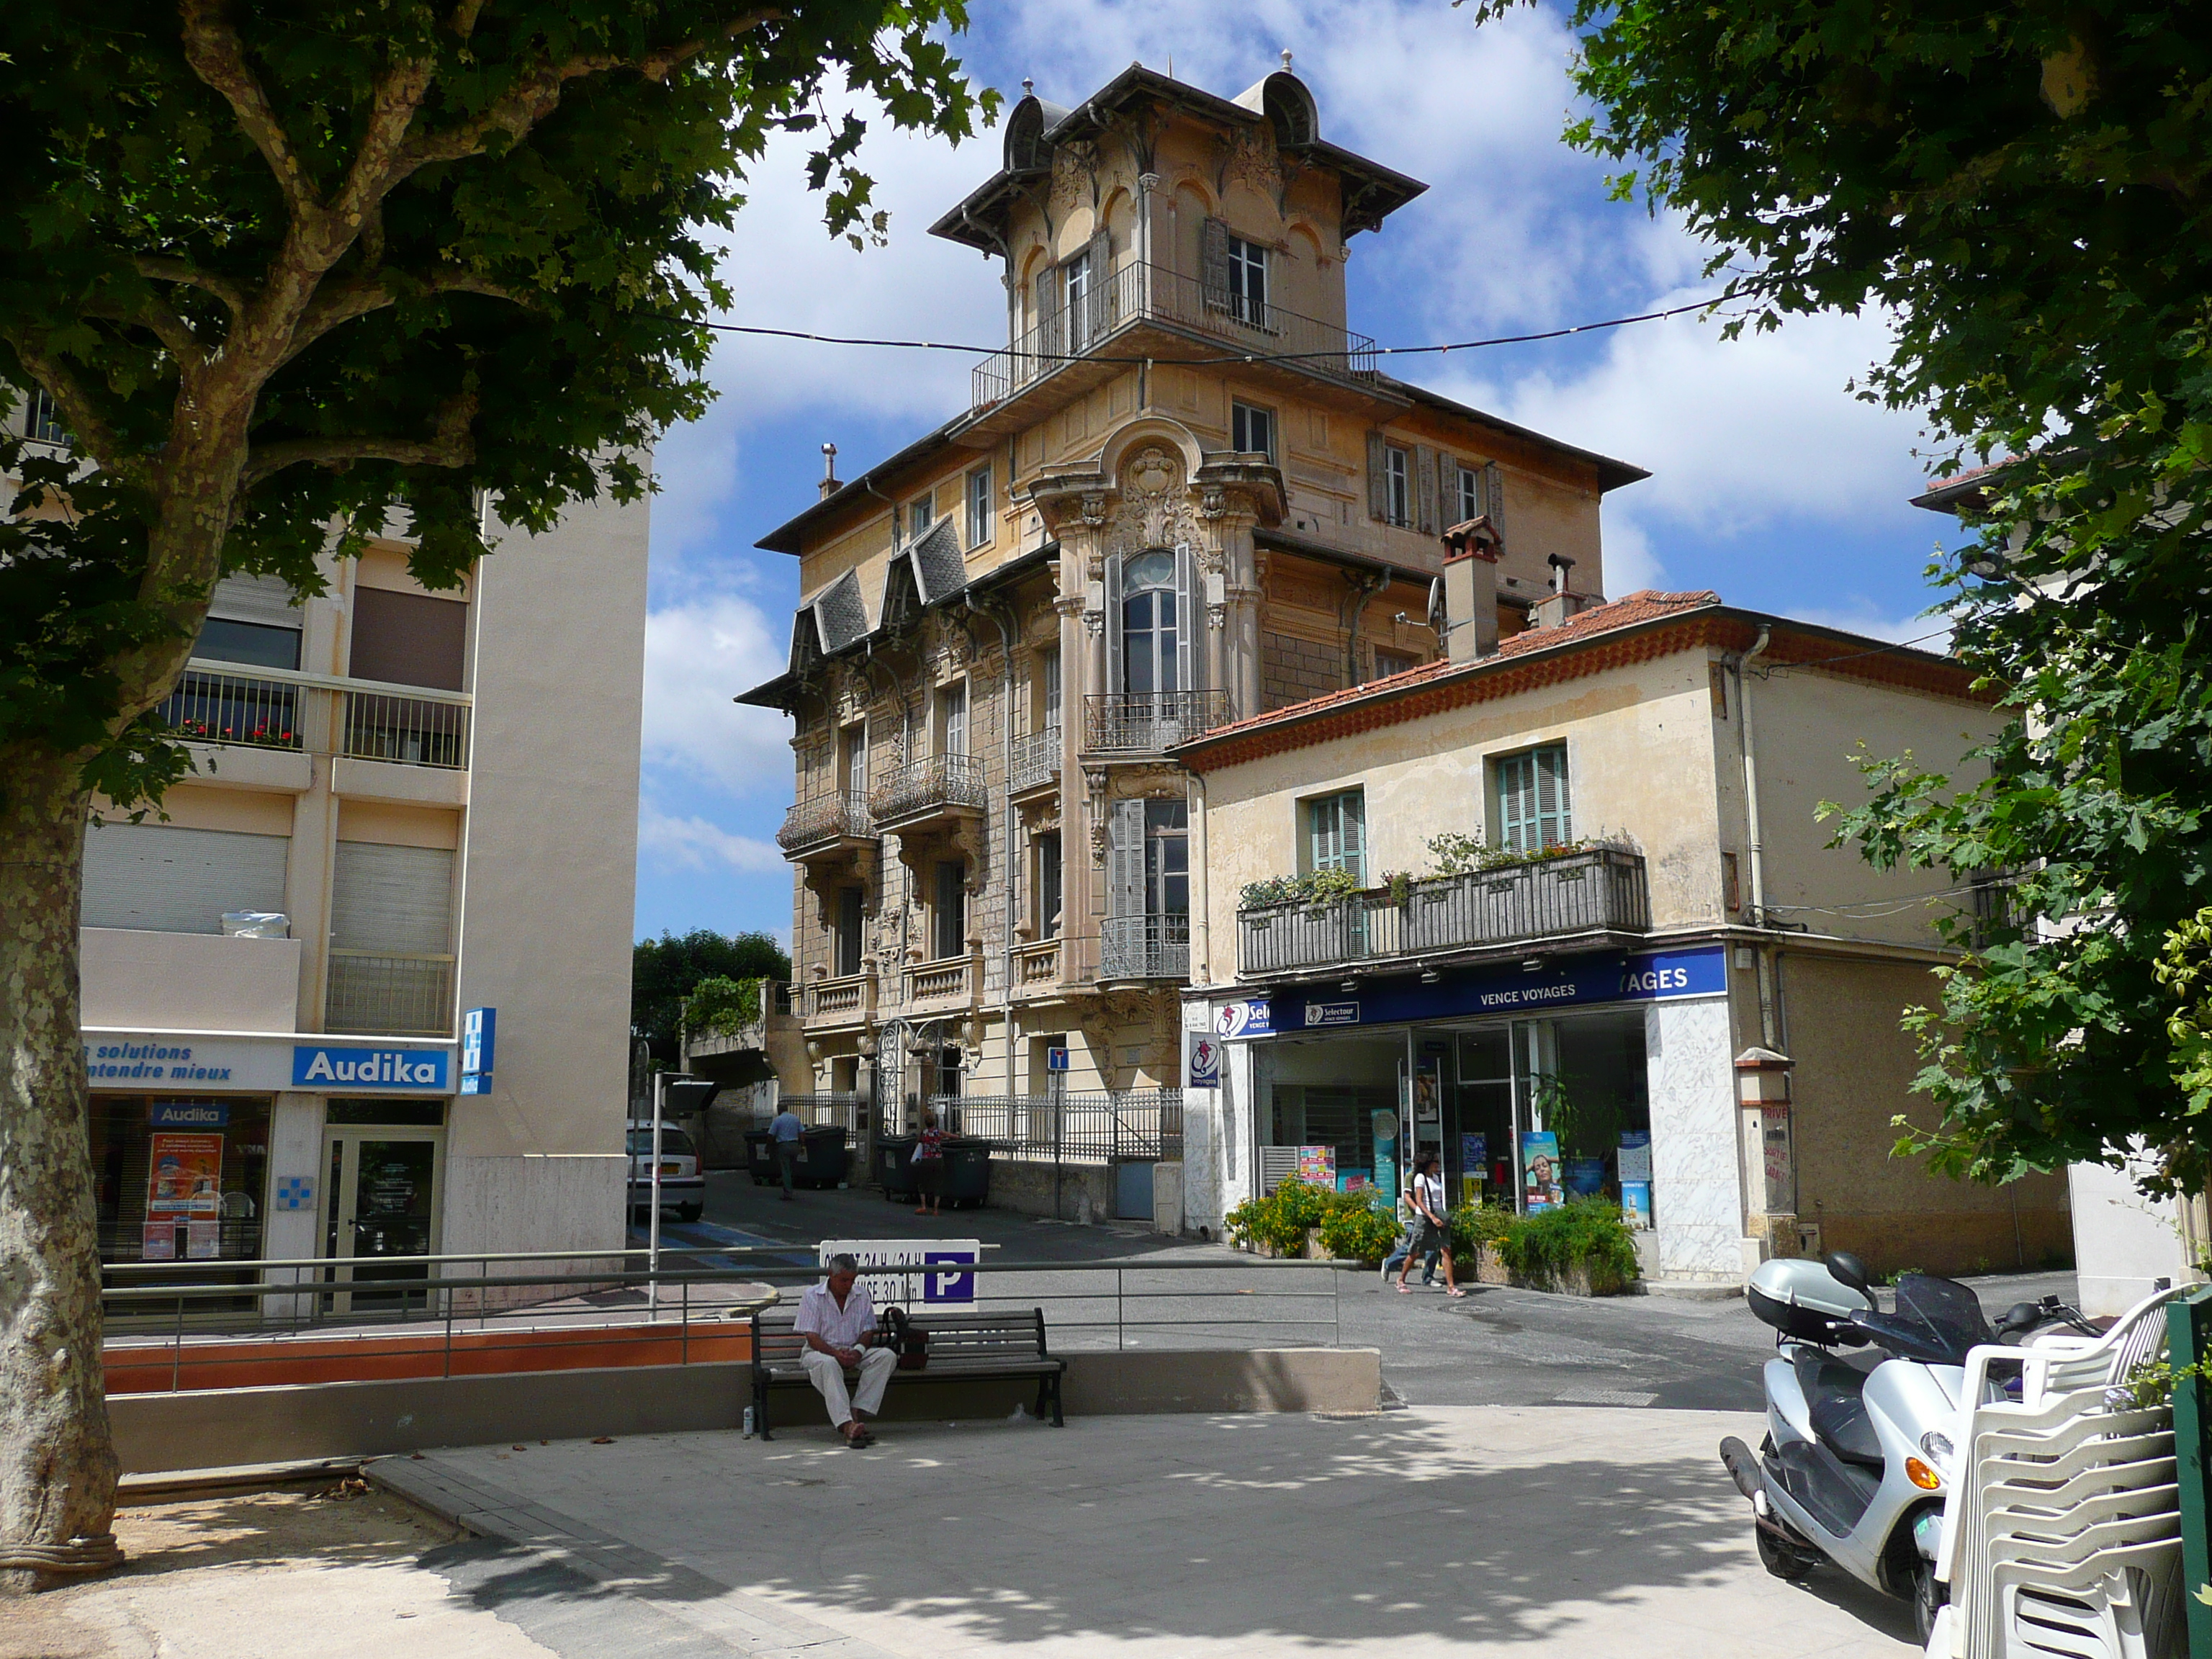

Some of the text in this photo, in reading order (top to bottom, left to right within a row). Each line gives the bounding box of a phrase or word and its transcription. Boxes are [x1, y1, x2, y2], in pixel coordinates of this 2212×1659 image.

[1480, 984, 1575, 1006] VENCE VOYAGES
[1249, 1005, 1270, 1021] Sel
[1323, 1007, 1354, 1017] Selectour
[96, 1043, 192, 1061] solutions
[170, 1063, 231, 1080] mieux
[305, 1051, 436, 1084] Audika
[160, 1108, 220, 1122] Audika
[883, 1280, 896, 1305] 30
